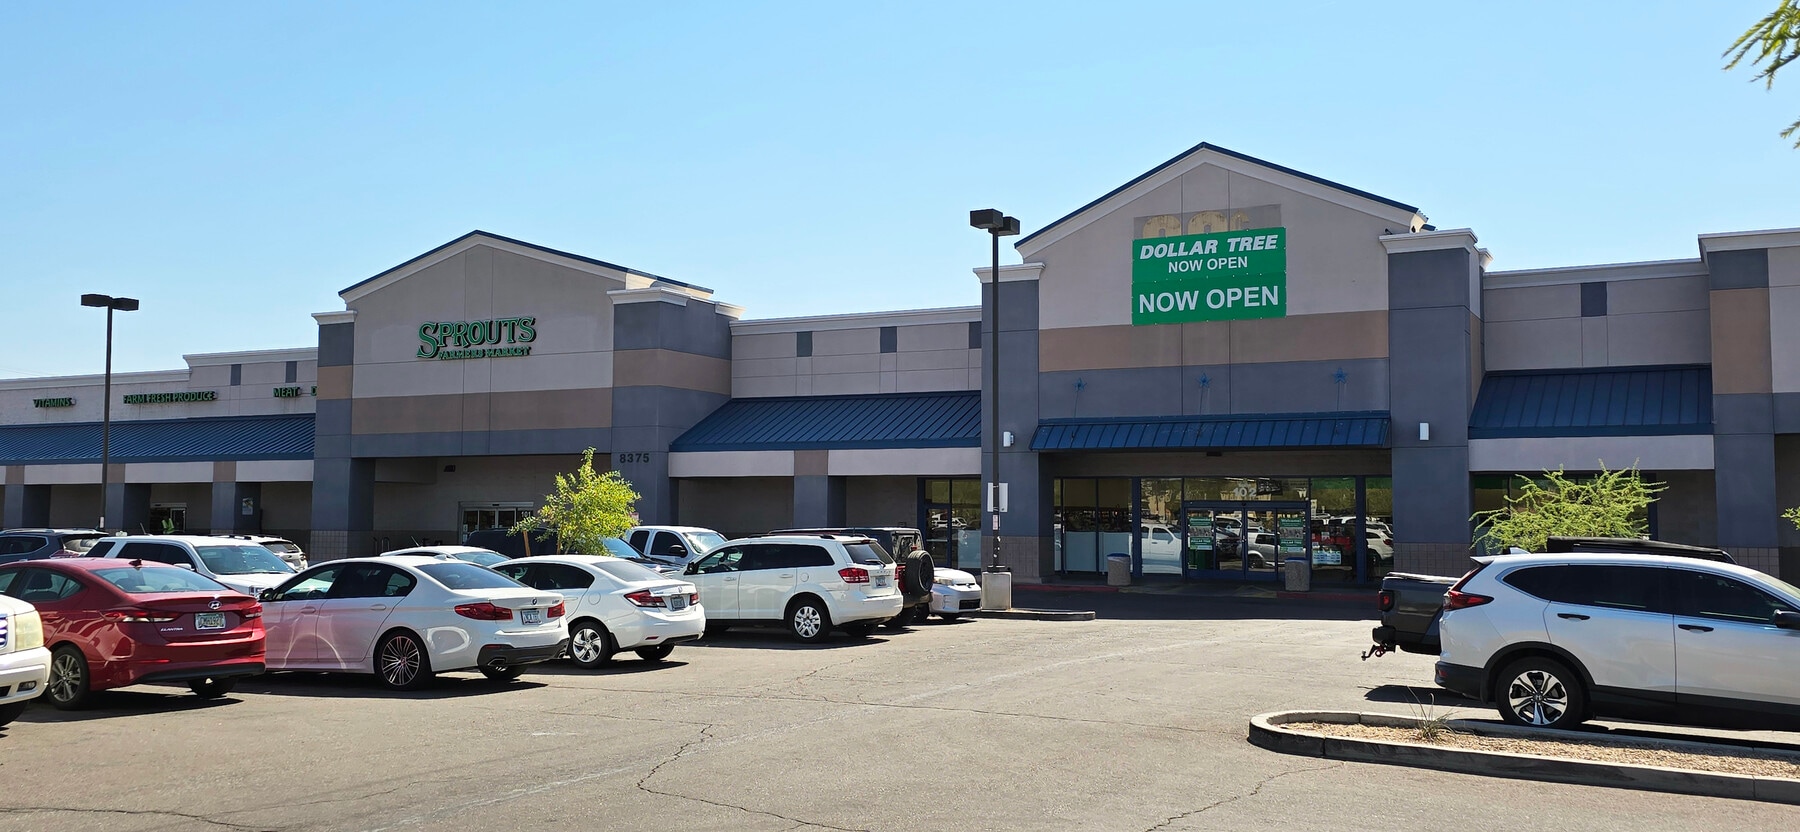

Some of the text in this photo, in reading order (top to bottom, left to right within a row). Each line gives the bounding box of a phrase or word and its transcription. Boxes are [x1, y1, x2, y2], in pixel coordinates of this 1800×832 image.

[1139, 234, 1279, 260] DOLLAR TREE
[1168, 256, 1248, 273] NOW OPEN
[1139, 285, 1279, 314] NOW OPEN
[416, 316, 537, 360] SPROUTS
[438, 345, 531, 360] FARMERS MARKET
[123, 390, 214, 404] FARM FRESH PRODUCE
[273, 386, 298, 398] MEAT
[33, 397, 72, 408] VITAMINS
[619, 452, 650, 464] 8375
[1233, 487, 1257, 497] 102
